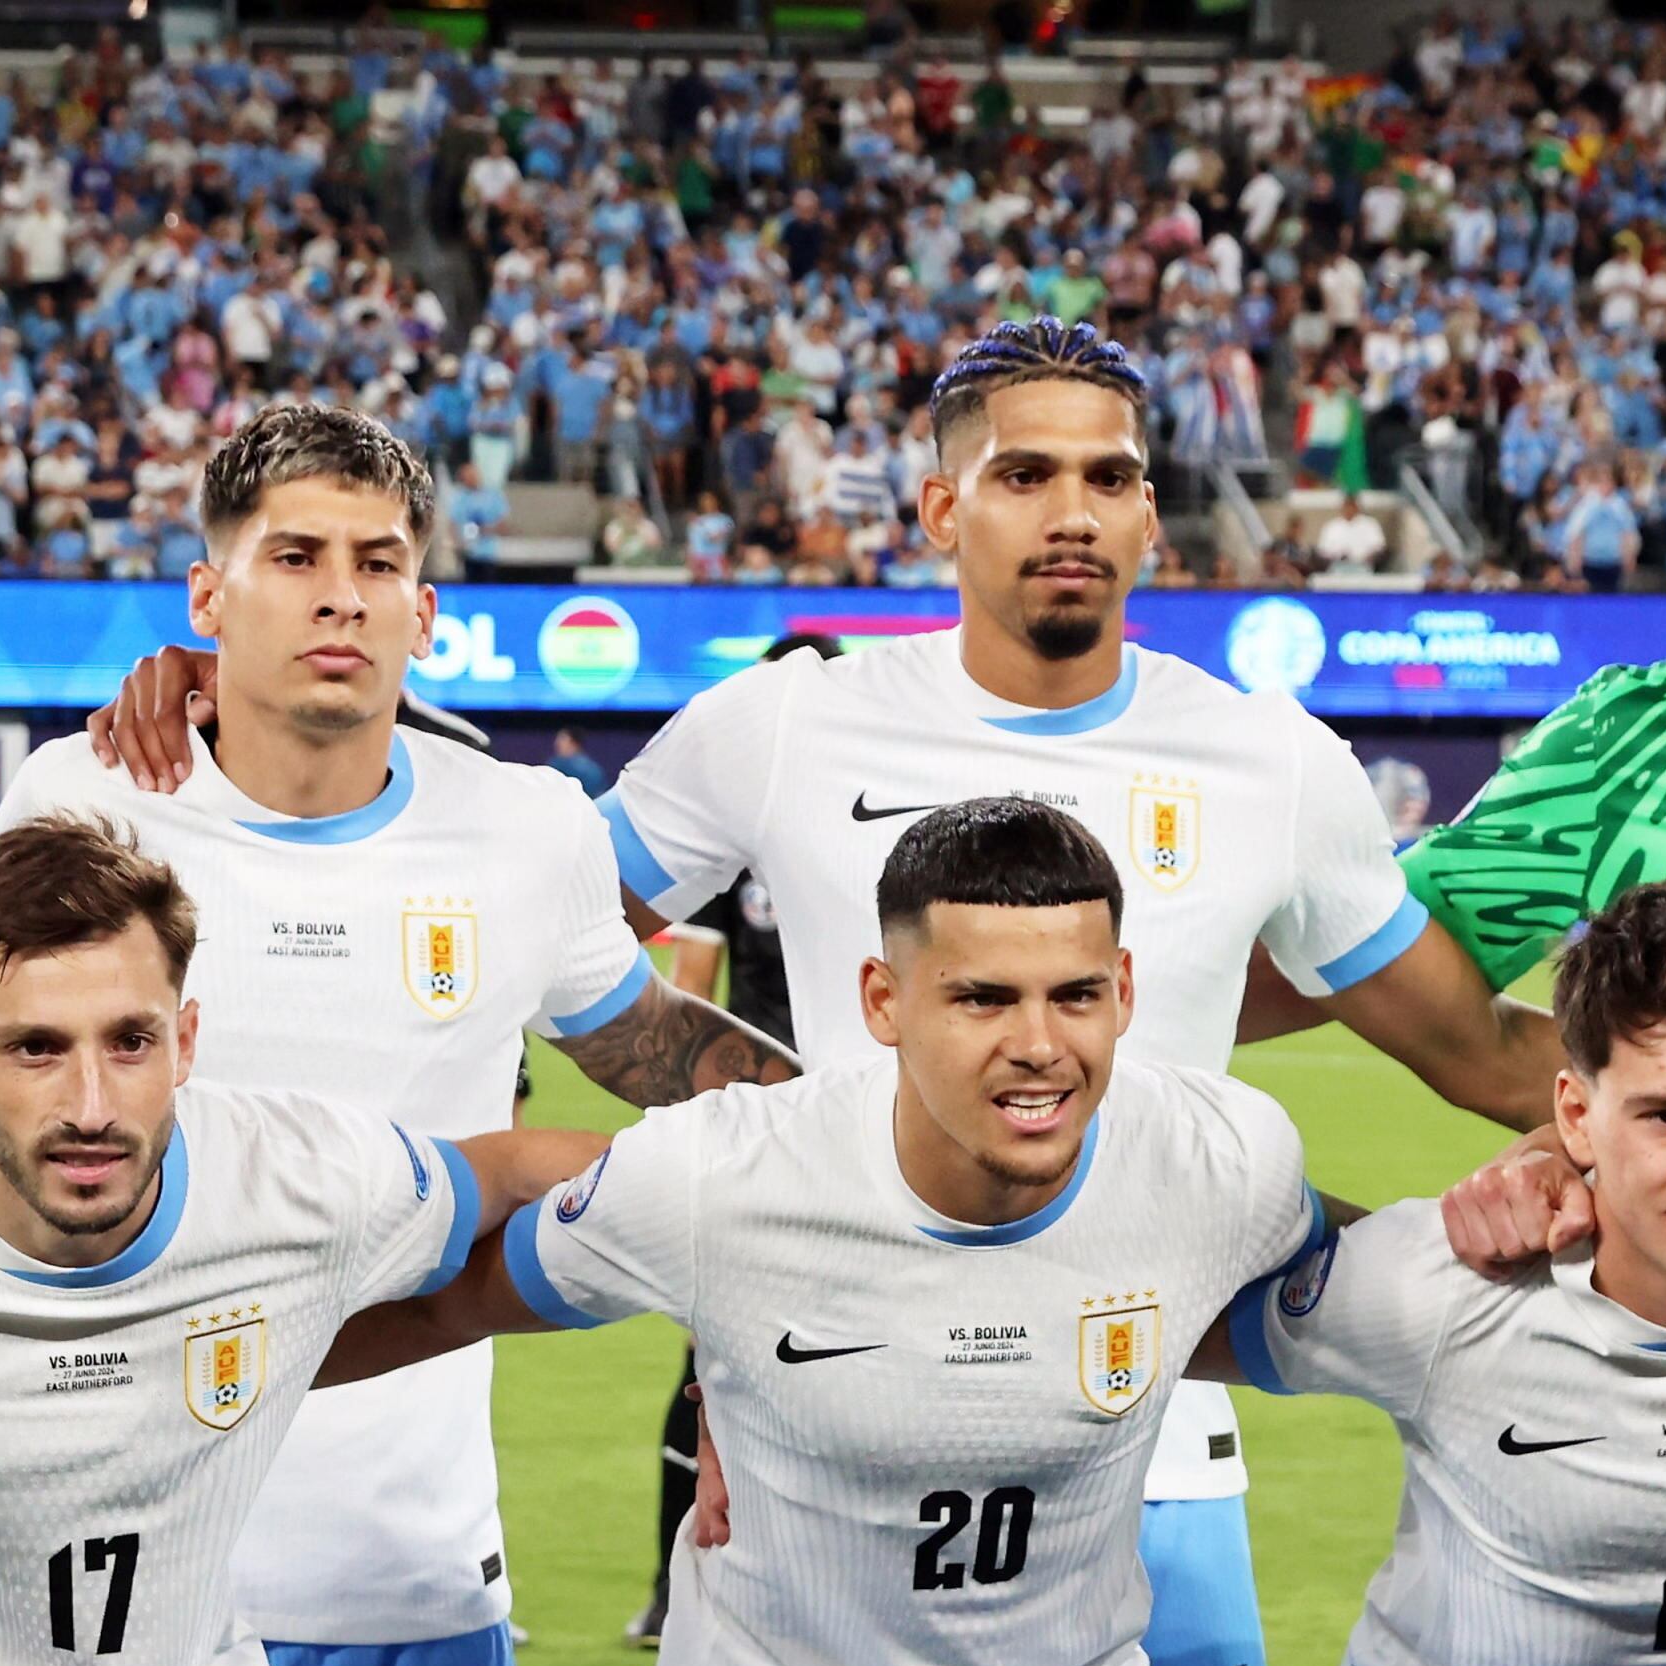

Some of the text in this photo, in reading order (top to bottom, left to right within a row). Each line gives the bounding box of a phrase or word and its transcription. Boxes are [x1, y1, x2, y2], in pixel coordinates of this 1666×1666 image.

[272, 922, 346, 936] VS. BOLIVIA
[949, 1326, 1027, 1341] VS. BOLIVIA
[1111, 1329, 1128, 1365] AUF
[49, 1352, 128, 1369] VS. BOLIVIA
[218, 1345, 235, 1381] AUF
[46, 1376, 133, 1392] EAST RUTHERFORD
[913, 1485, 1035, 1590] 20
[49, 1533, 139, 1655] 17
